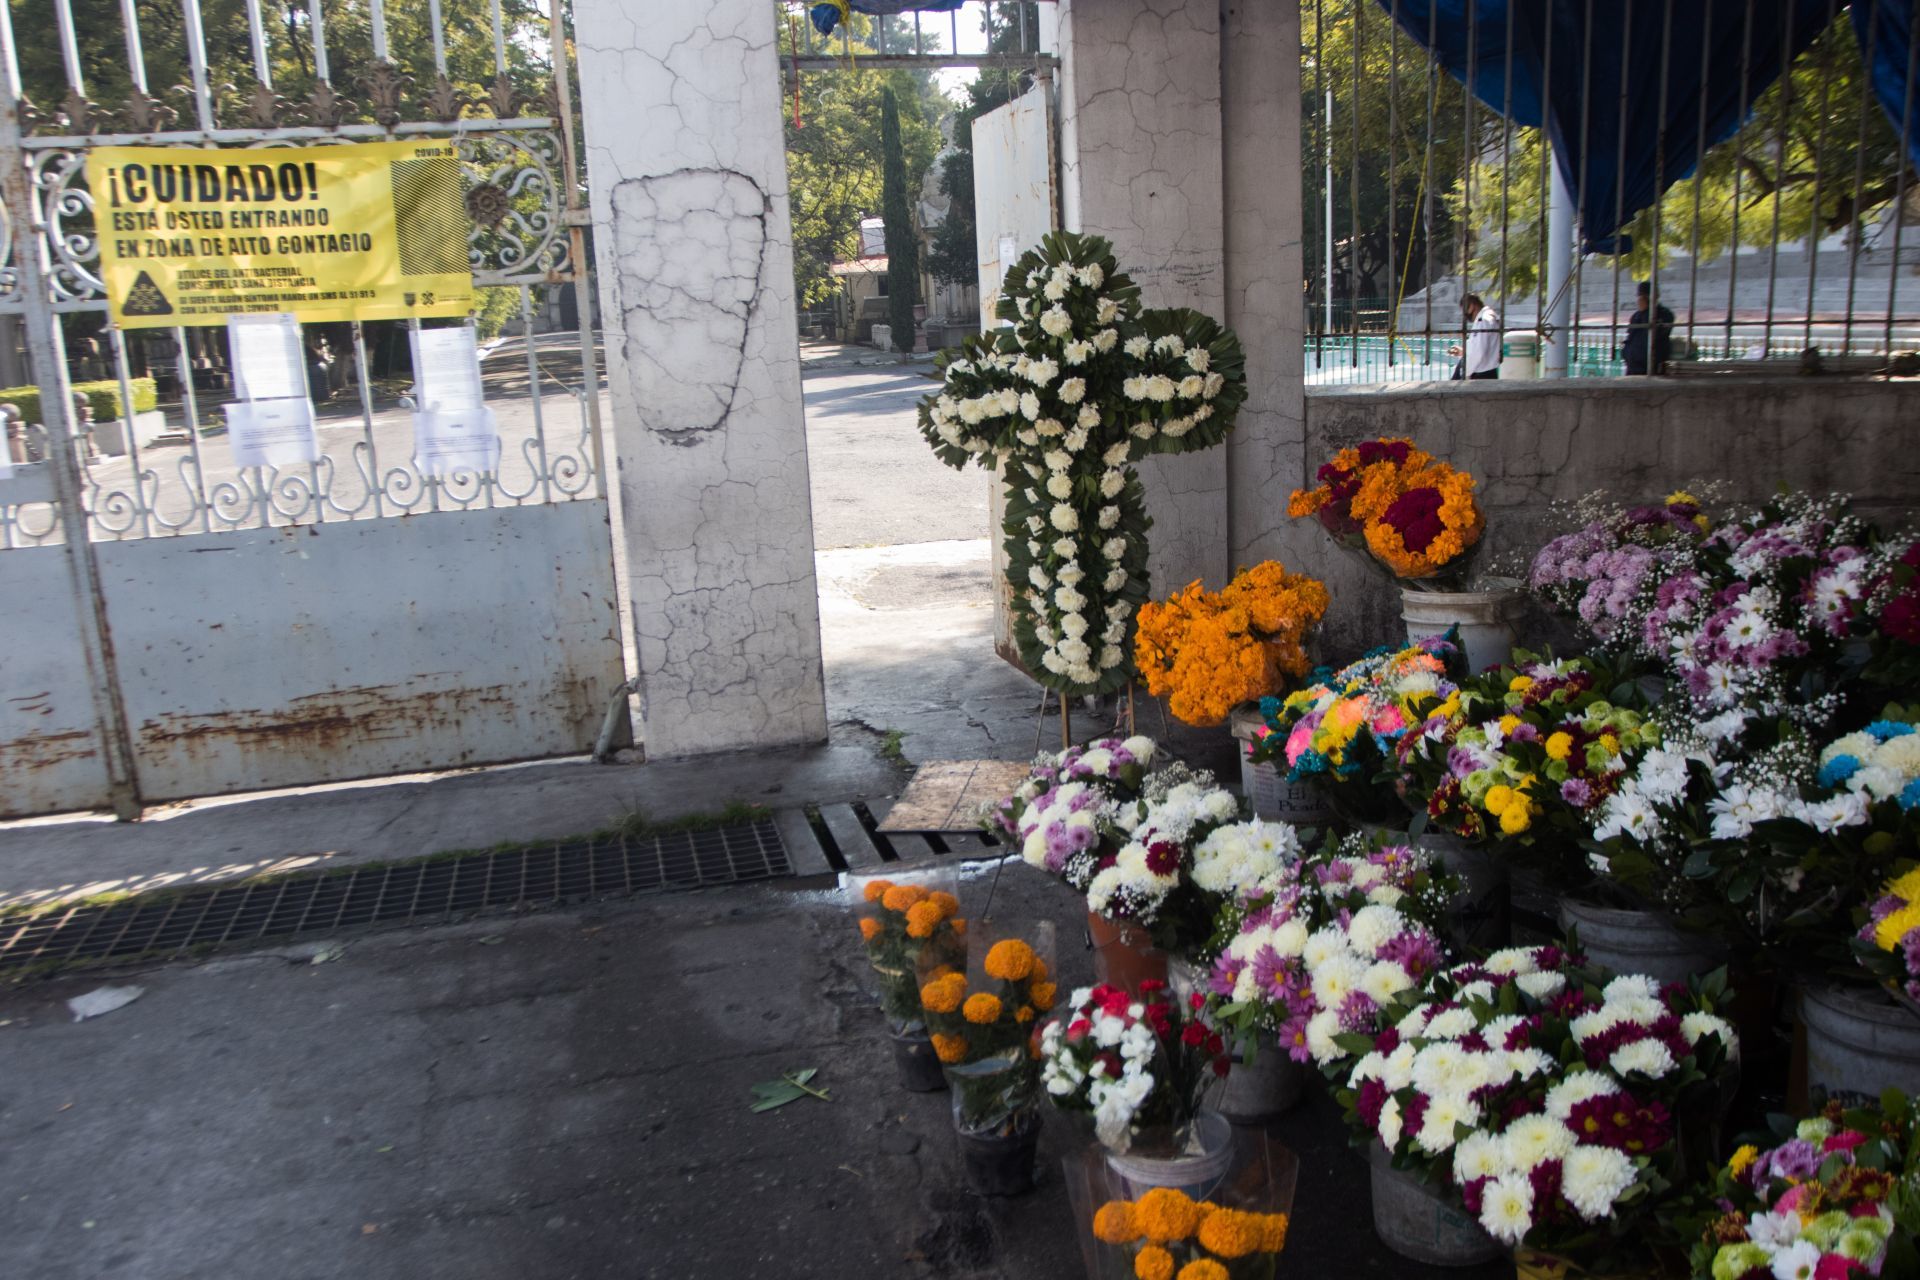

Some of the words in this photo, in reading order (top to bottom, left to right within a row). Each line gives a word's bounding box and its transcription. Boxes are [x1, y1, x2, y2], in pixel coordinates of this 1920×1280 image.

[108, 162, 319, 208] ¡CUIDADO!
[113, 208, 160, 231] ESTÁ
[165, 210, 224, 230] USTED
[229, 208, 329, 229] ENTRANDO
[115, 239, 140, 258] EN
[145, 238, 195, 257] ZONA
[201, 237, 224, 257] DE
[228, 236, 271, 256] ALTO
[277, 233, 372, 255] CONTAGIO
